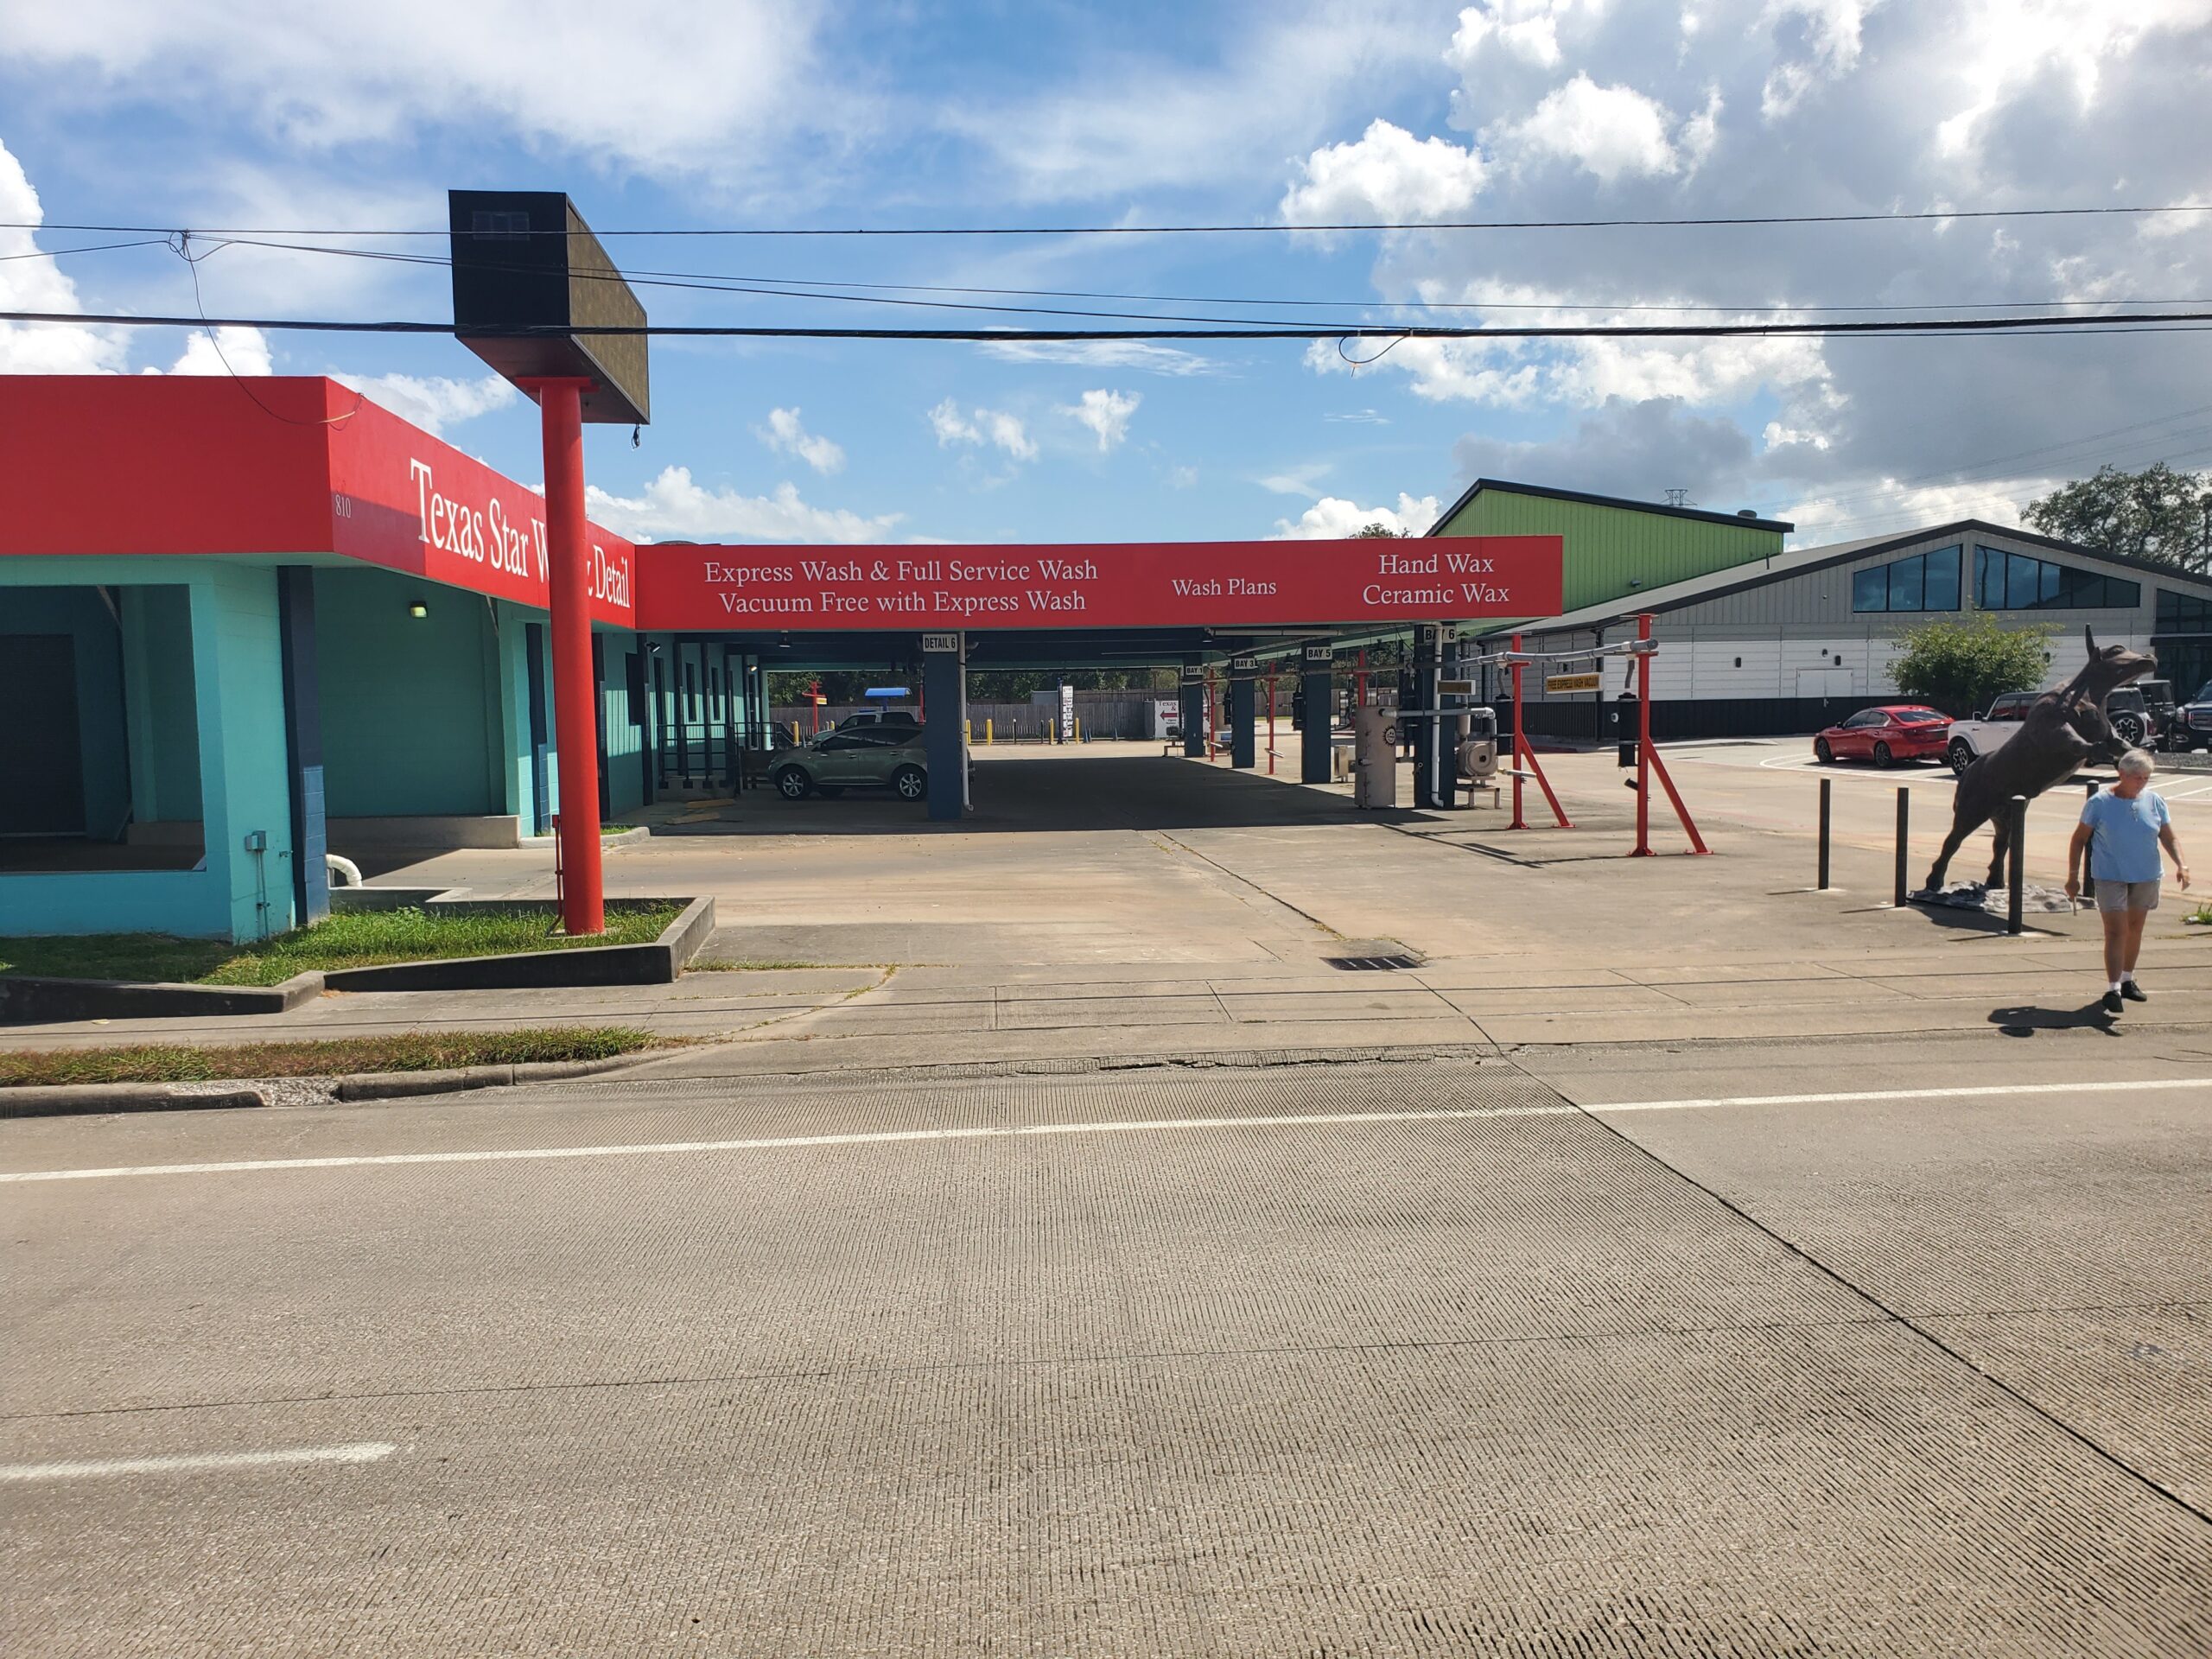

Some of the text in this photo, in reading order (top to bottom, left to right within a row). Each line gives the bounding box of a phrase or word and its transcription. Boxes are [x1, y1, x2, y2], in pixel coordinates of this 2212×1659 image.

[335, 493, 352, 518] 810
[410, 457, 484, 563] Texas
[489, 498, 529, 578] Star
[593, 543, 630, 608] Detail
[704, 558, 1098, 587] Express Wash & Full Service Wash
[1378, 553, 1495, 575] Hand Wax
[1172, 578, 1277, 596] Wash Plans
[1363, 582, 1510, 605] Ceramic Wax
[719, 590, 1086, 617] Vacuum Free with Express Wash
[925, 637, 956, 649] DETAIL 6
[1448, 628, 1455, 639] 6
[1307, 649, 1324, 658] BAY
